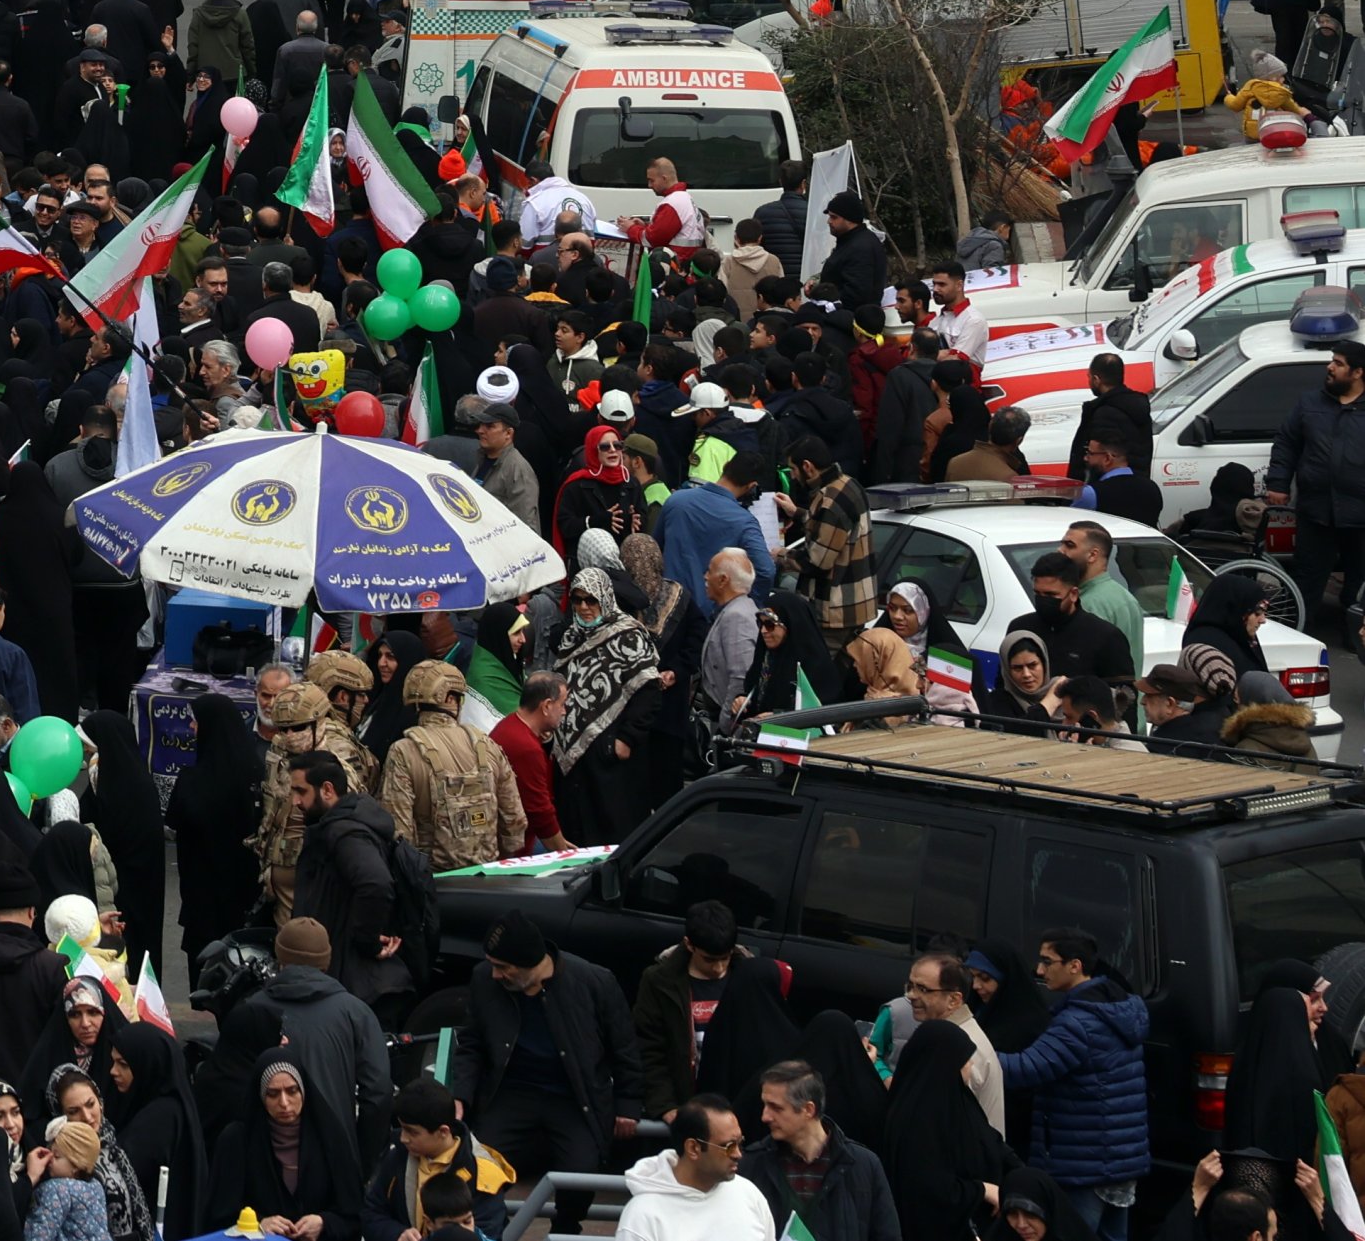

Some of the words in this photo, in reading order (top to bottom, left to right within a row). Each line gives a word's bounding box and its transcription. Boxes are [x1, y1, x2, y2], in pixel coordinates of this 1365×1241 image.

[612, 70, 745, 88] AMBULANCE
[361, 544, 393, 556] زندانیان
[394, 544, 418, 556] آزادی
[431, 543, 450, 552] کمک
[242, 563, 272, 578] پیامکی
[274, 567, 300, 581] سامانه
[328, 573, 361, 589] نذورات
[363, 579, 369, 589] و
[371, 573, 396, 586] صدقه
[398, 575, 437, 589] پرداخت
[438, 572, 467, 585] سامانه
[270, 588, 291, 600] نظرات
[367, 592, 411, 610] ۷۳۵۵
